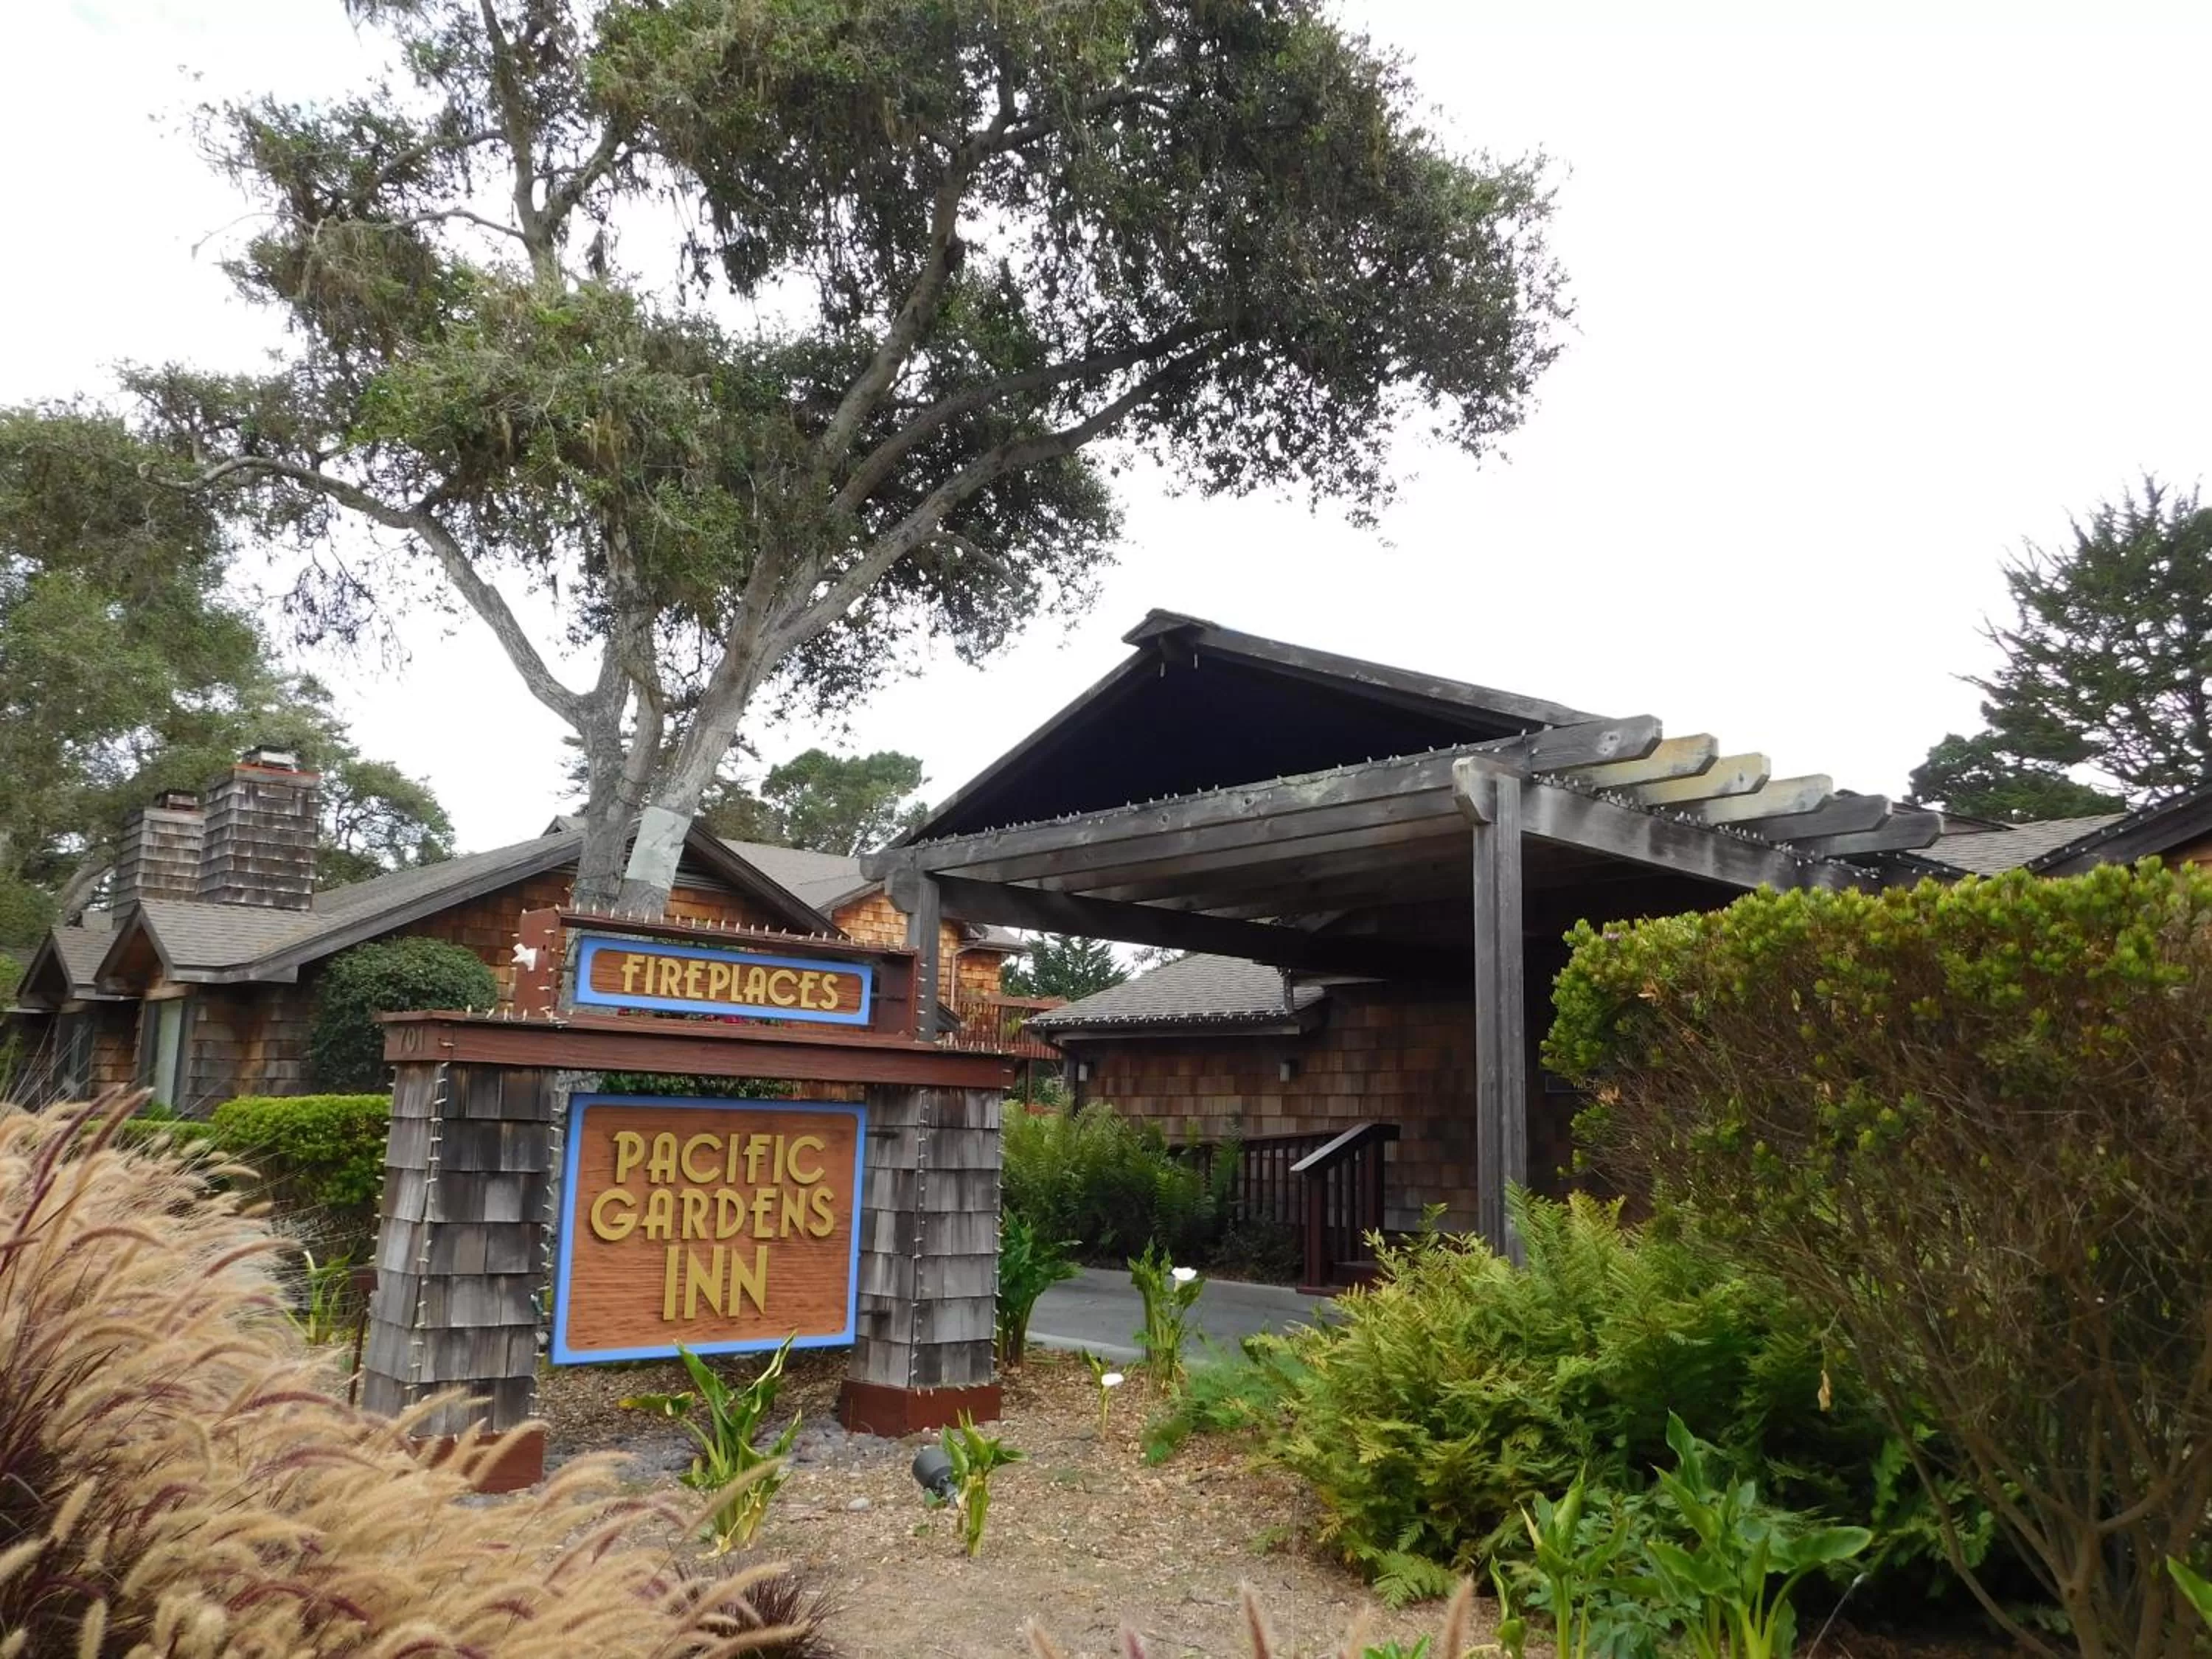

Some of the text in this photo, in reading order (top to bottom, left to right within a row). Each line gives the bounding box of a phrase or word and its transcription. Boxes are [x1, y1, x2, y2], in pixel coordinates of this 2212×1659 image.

[621, 953, 839, 1010] FIREPLACES
[397, 1026, 425, 1053] 701
[613, 1131, 826, 1184] PACIFIC
[591, 1188, 835, 1241] GARDENS
[663, 1245, 768, 1321] INN
